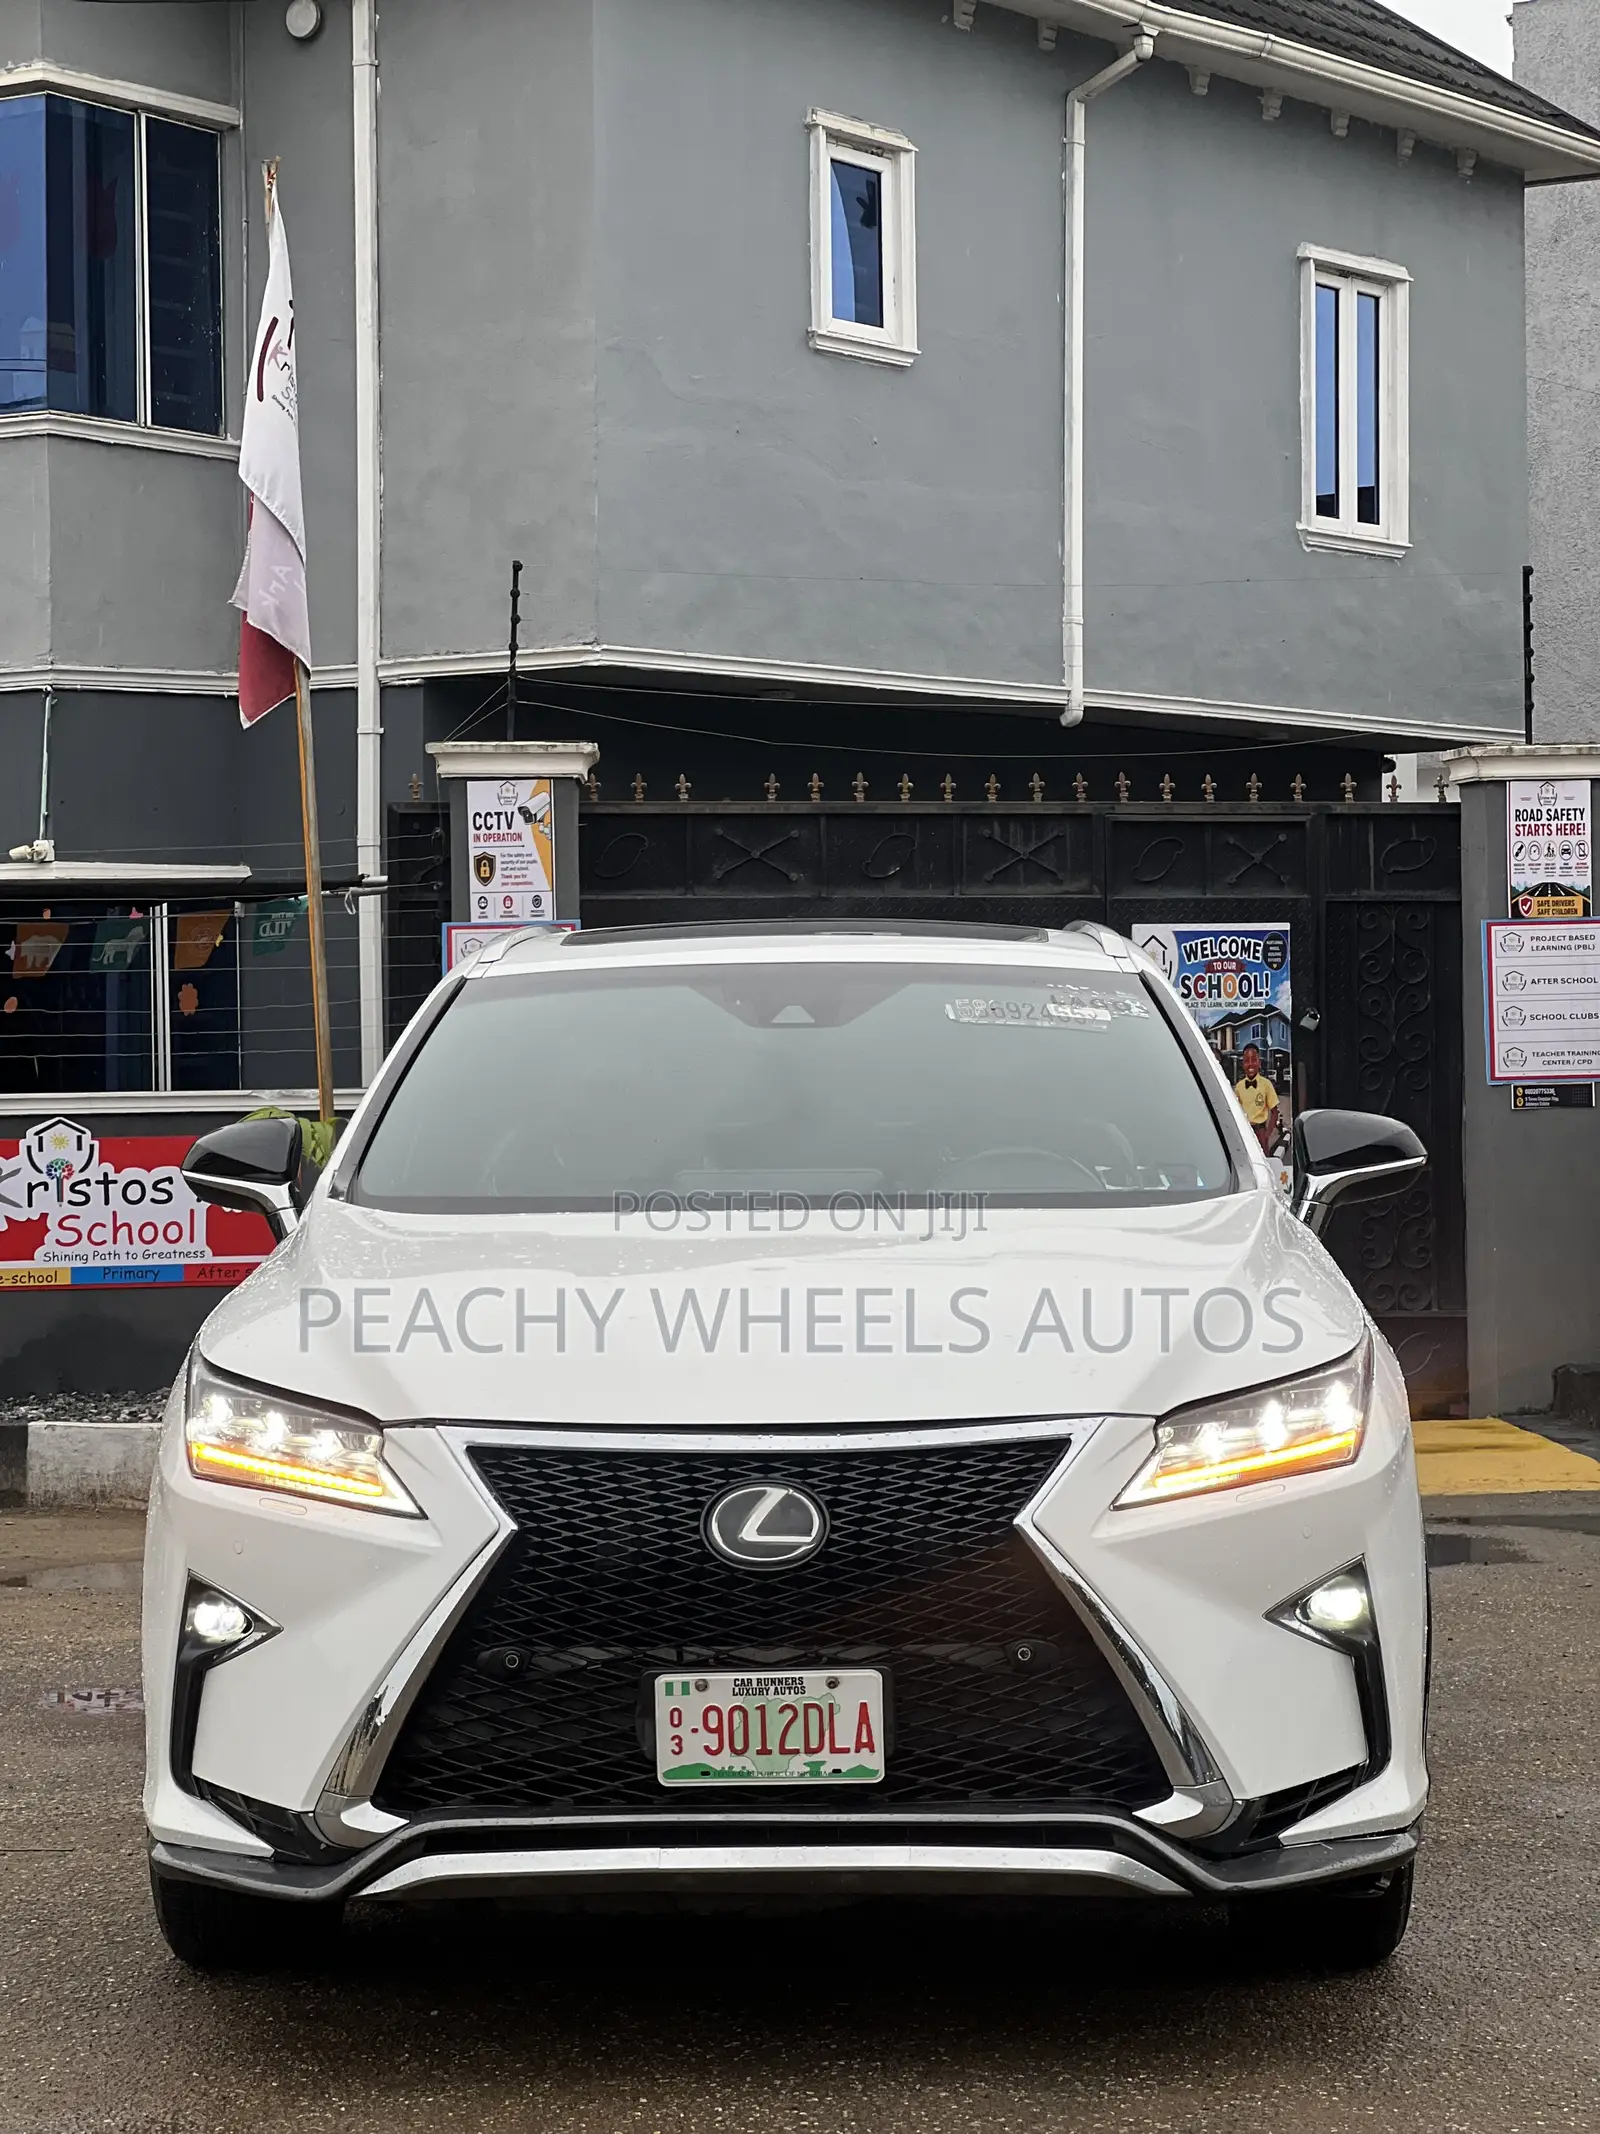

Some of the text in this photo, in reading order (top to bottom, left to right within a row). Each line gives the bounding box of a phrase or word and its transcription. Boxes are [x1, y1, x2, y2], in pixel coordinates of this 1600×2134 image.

[473, 811, 515, 831] CCTV
[1515, 808, 1586, 822] ROAD SAFETY
[1515, 822, 1586, 836] STARTS HERE!
[473, 832, 522, 842] IN OPERATION
[1551, 899, 1575, 907] DRIVERS
[1182, 938, 1262, 963] WELCOME
[1223, 962, 1237, 970] OUR
[1180, 972, 1270, 999] SCHOOL!
[1530, 976, 1598, 985] AFTER SCHOOL
[1530, 1013, 1567, 1021] SCHOOL
[1570, 1012, 1599, 1020] CLUBS
[55, 1209, 195, 1247] School
[43, 1249, 206, 1264] Shining Path to Greatness
[103, 1267, 160, 1282] Primary
[197, 1266, 240, 1279] After
[733, 1677, 804, 1687] CAR RUNNERS
[732, 1686, 807, 1697] LUXURY AUTOS
